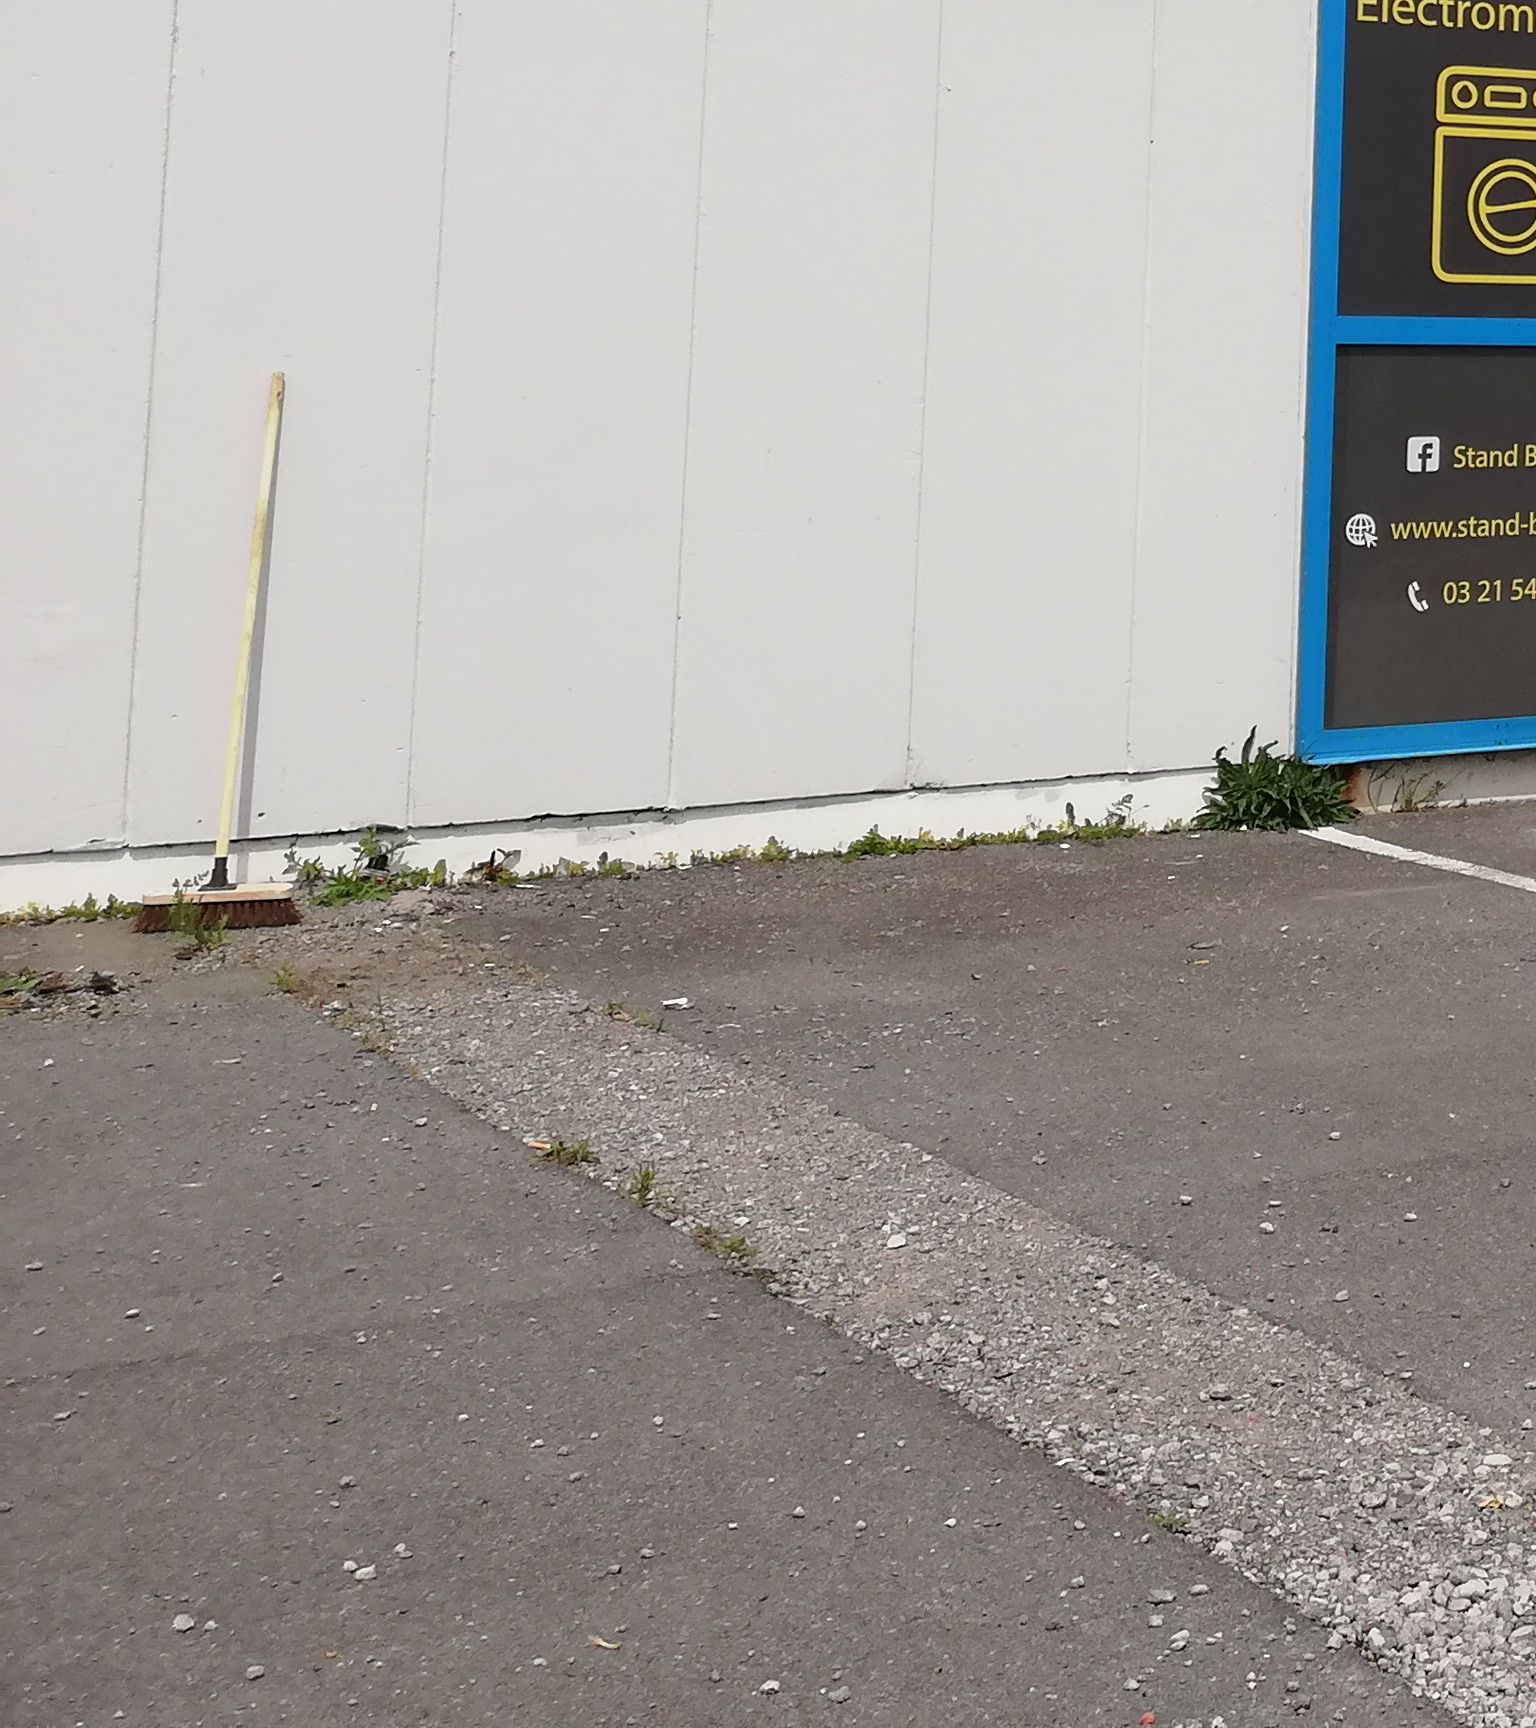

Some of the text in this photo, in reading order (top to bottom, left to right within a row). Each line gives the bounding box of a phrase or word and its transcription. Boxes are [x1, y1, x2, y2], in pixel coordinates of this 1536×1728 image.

[1453, 443, 1519, 469] Stand
[1443, 581, 1471, 604] 03
[1477, 579, 1502, 603] 21
